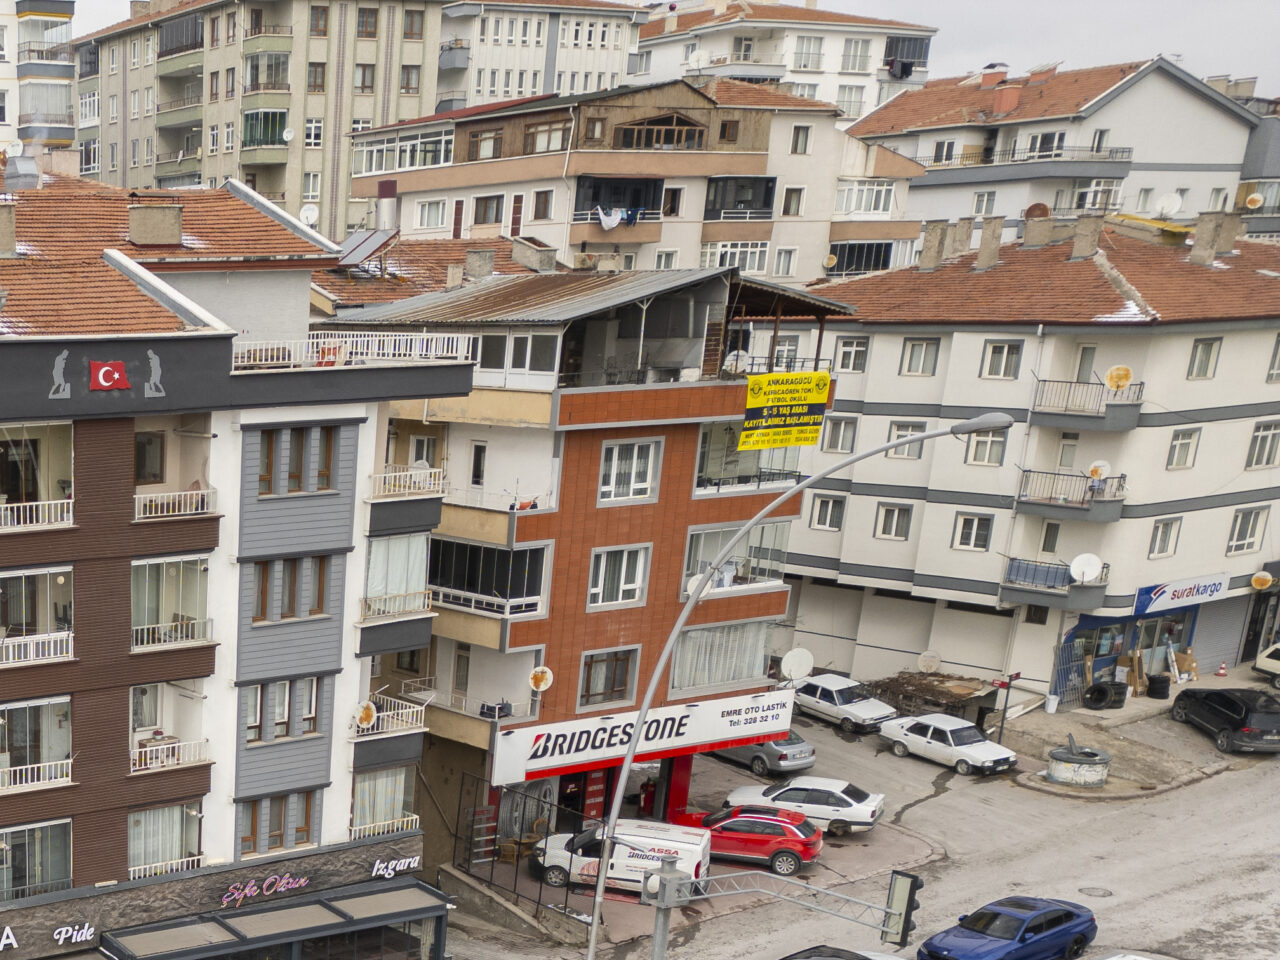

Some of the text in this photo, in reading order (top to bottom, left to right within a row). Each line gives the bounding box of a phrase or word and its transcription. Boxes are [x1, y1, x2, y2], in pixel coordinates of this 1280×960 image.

[721, 708, 743, 719] EMRE
[744, 705, 760, 716] OTO
[759, 715, 769, 724] 32
[53, 922, 95, 945] Pide
